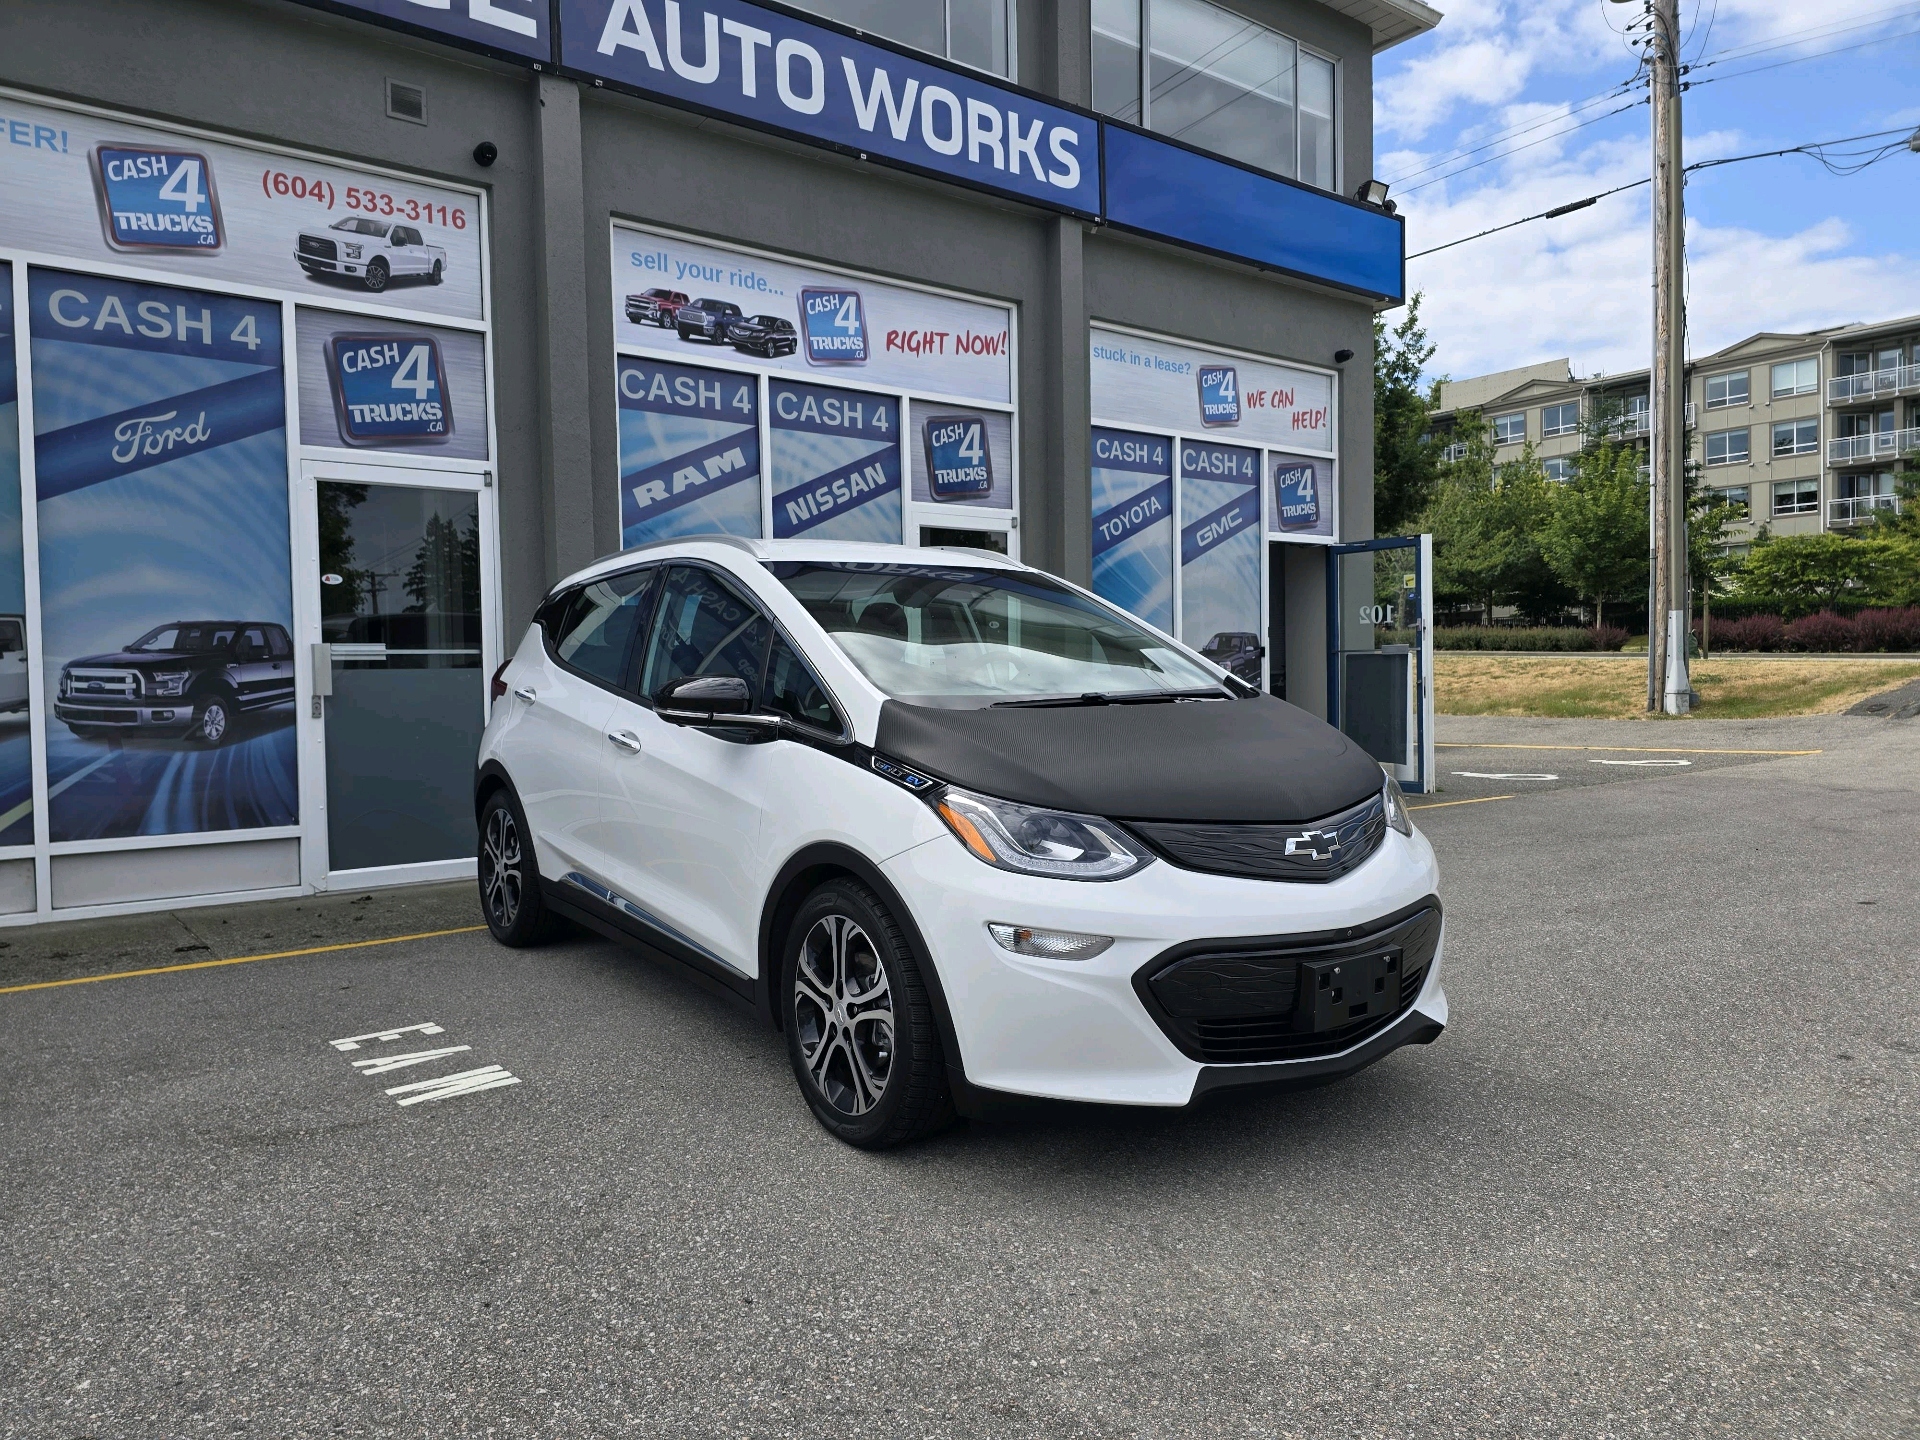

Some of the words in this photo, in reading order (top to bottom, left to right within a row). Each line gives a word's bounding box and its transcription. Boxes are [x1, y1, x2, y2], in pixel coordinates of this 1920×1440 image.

[597, 0, 825, 115] AUTO
[841, 56, 1081, 190] WORKS
[0, 118, 68, 154] ER!
[107, 155, 168, 181] CASH
[159, 159, 205, 212] 4
[262, 170, 335, 210] (604)
[346, 187, 466, 230] 533-3116
[114, 212, 214, 233] TRUCKS
[197, 234, 214, 245] .CA
[631, 251, 668, 273] sell
[675, 260, 723, 282] your
[729, 269, 784, 296] ride...
[48, 289, 212, 346] CASH
[230, 315, 261, 351] 4
[807, 294, 839, 315] CASH
[834, 296, 859, 335] 4
[810, 336, 864, 350] TRUCKS
[886, 329, 950, 358] RIGHT
[955, 329, 1007, 356] NOW!
[342, 343, 399, 373] CASH
[391, 345, 435, 400] 4
[1093, 346, 1126, 363] stuck
[1130, 350, 1140, 366] in
[1144, 356, 1151, 368] a
[1154, 355, 1191, 375] lease?
[619, 369, 721, 411] CASH
[732, 386, 752, 414] 4
[1202, 370, 1223, 388] CASH
[1219, 371, 1235, 402] 4
[1247, 389, 1267, 409] WE
[1270, 387, 1294, 409] CAN
[348, 402, 443, 423] TRUCKS
[776, 392, 863, 429] CASH
[872, 405, 889, 432] 4
[1203, 403, 1237, 415] TRUCKS
[1292, 406, 1327, 431] HELP!
[112, 410, 211, 464] Ford
[427, 421, 443, 432] .CA
[932, 423, 964, 447] CASH
[958, 424, 983, 465] 4
[1096, 438, 1148, 464] CASH
[1152, 446, 1164, 465] 4
[632, 446, 747, 509] RAM
[935, 466, 988, 484] TRUCKS
[1182, 448, 1237, 476] CASH
[1242, 457, 1253, 478] 4
[785, 462, 887, 525] NISSAN
[1280, 468, 1301, 488] CASH
[1297, 468, 1313, 502] 4
[1099, 496, 1162, 541] TOYOTA
[1196, 507, 1243, 547] GMC
[1282, 502, 1316, 518] TRUCKS
[906, 775, 924, 786] EV
